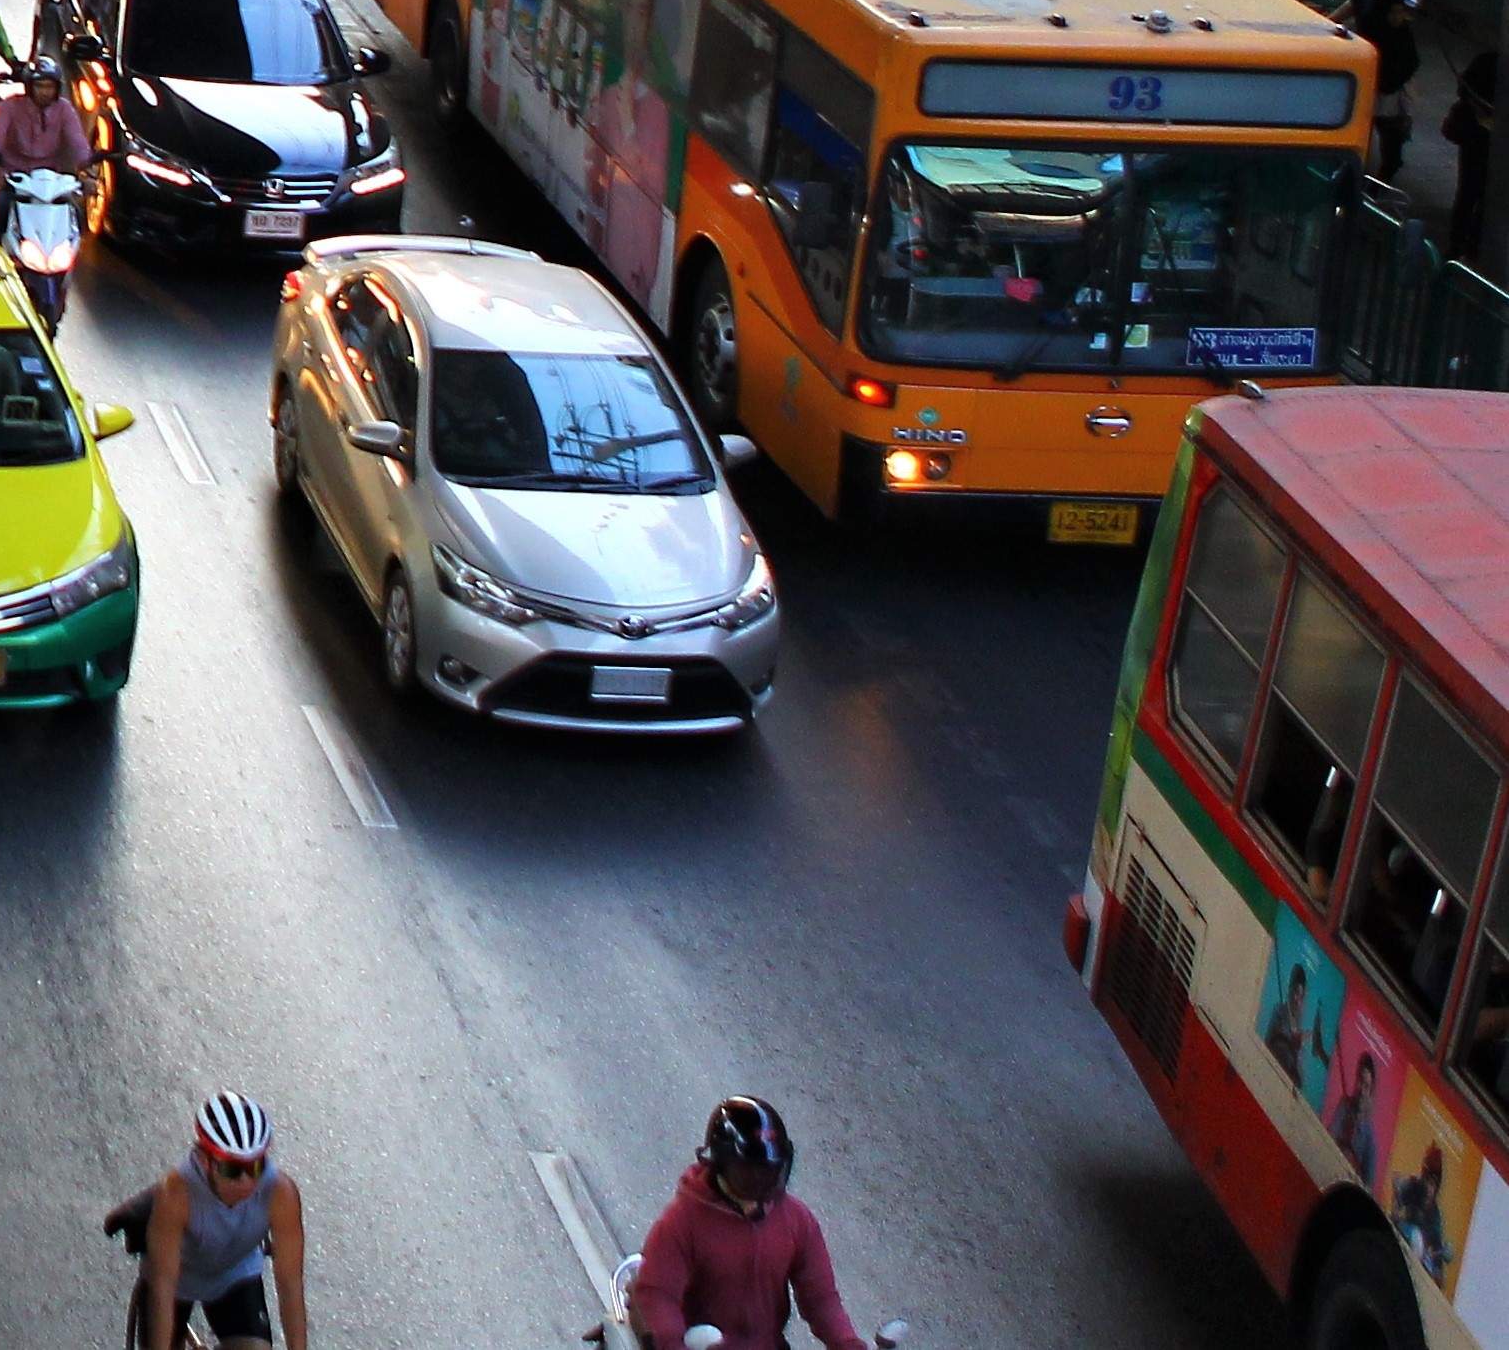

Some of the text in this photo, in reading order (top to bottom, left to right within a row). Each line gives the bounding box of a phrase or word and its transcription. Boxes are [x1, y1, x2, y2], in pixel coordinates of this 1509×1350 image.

[1109, 76, 1162, 111] 93
[893, 426, 968, 444] HINO
[1057, 510, 1129, 531] 12-5241
